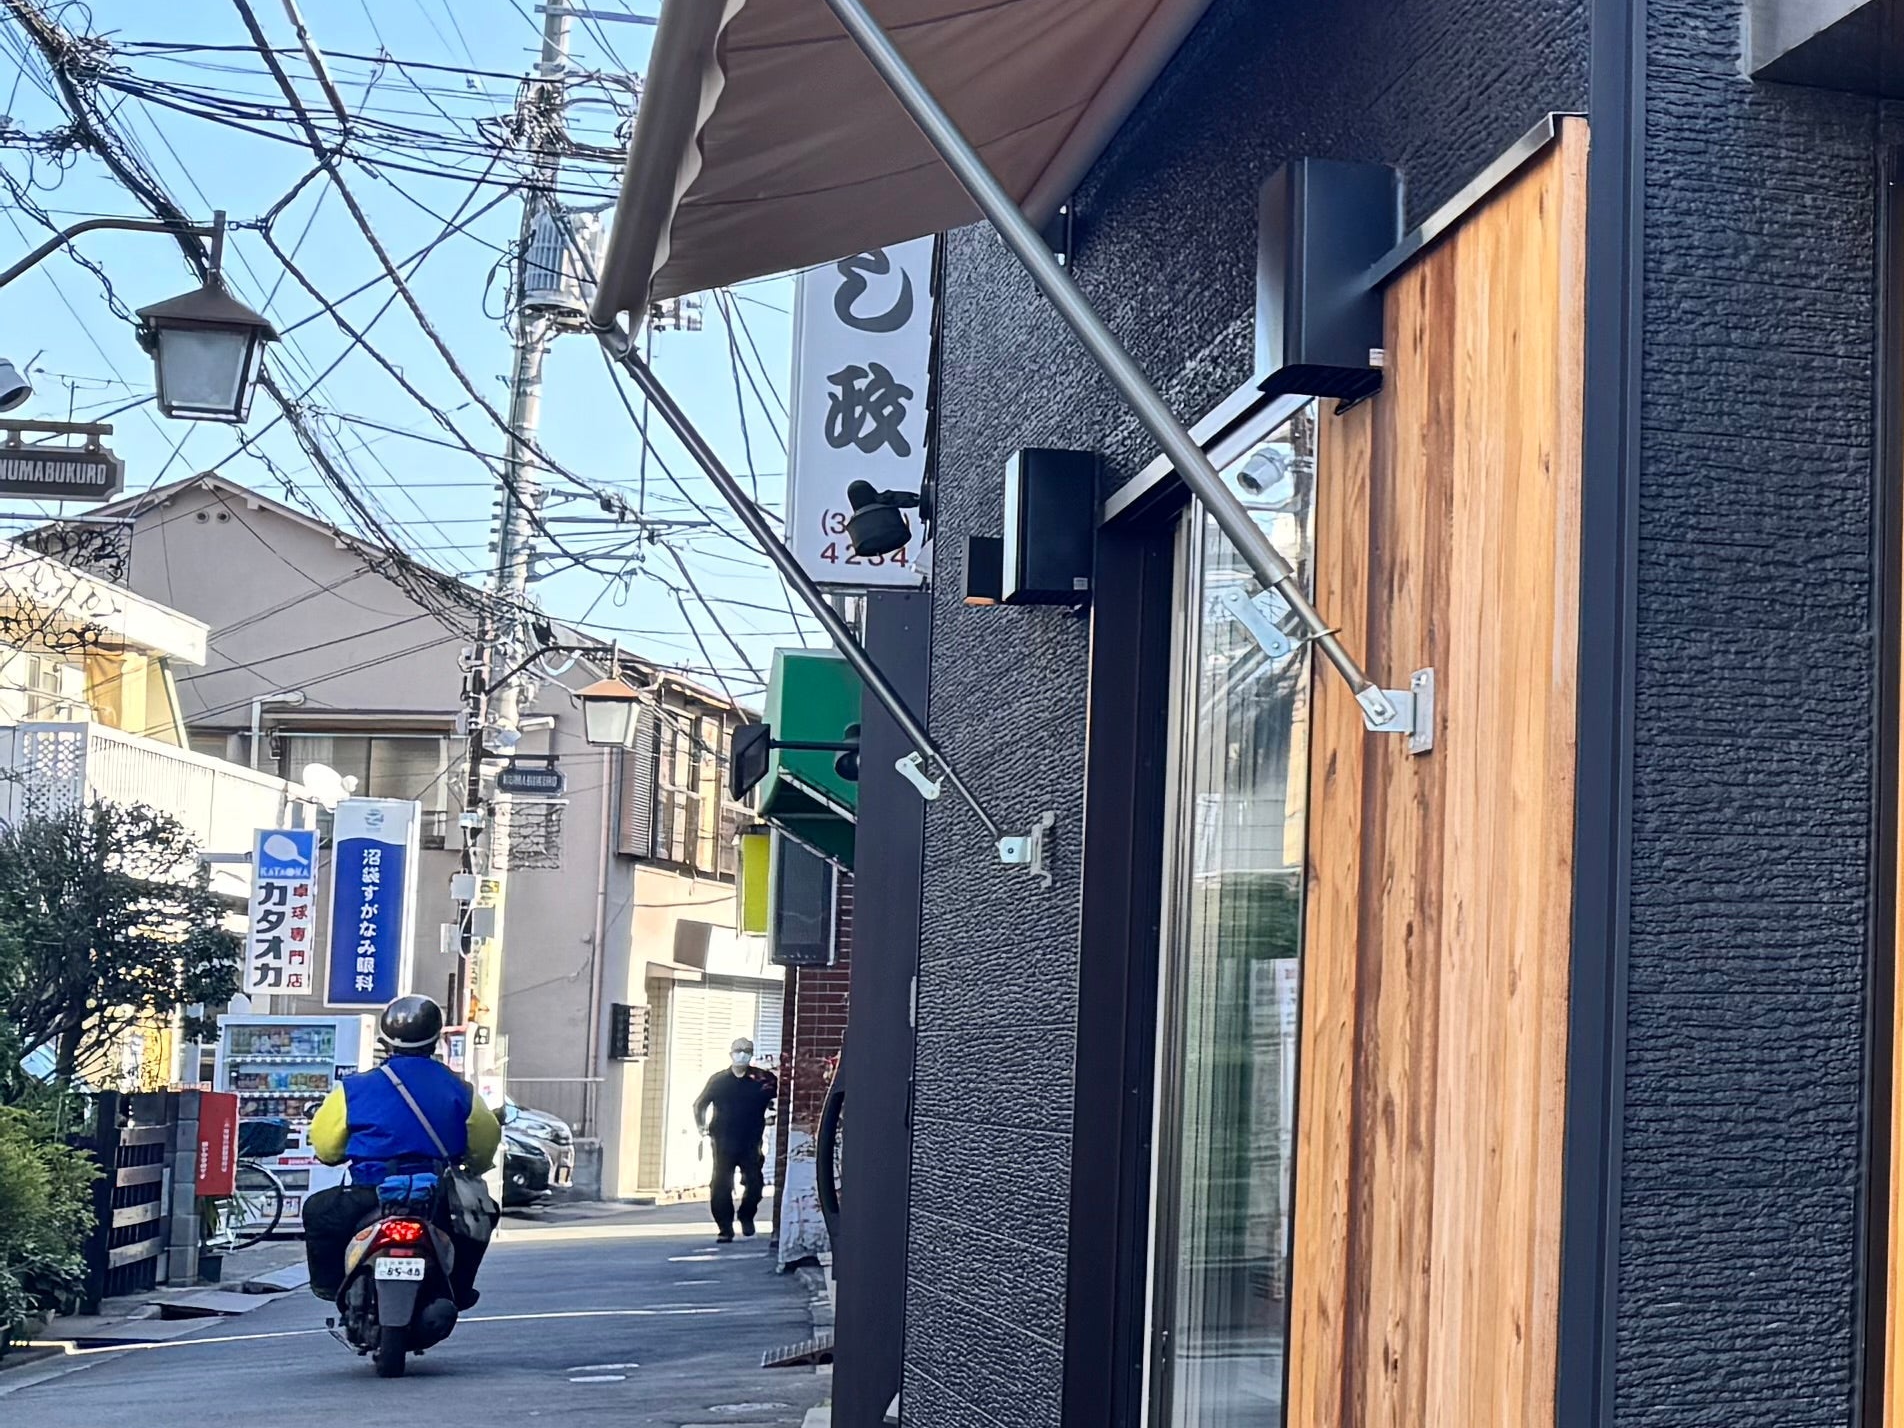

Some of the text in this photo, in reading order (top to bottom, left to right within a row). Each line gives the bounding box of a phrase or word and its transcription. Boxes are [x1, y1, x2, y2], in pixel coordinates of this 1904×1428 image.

[0, 459, 107, 485] NUMABUKURO
[252, 882, 288, 988] カタオカ
[286, 883, 309, 989] 卓球専門店
[355, 848, 382, 992] 沼袋すがなみ眼科
